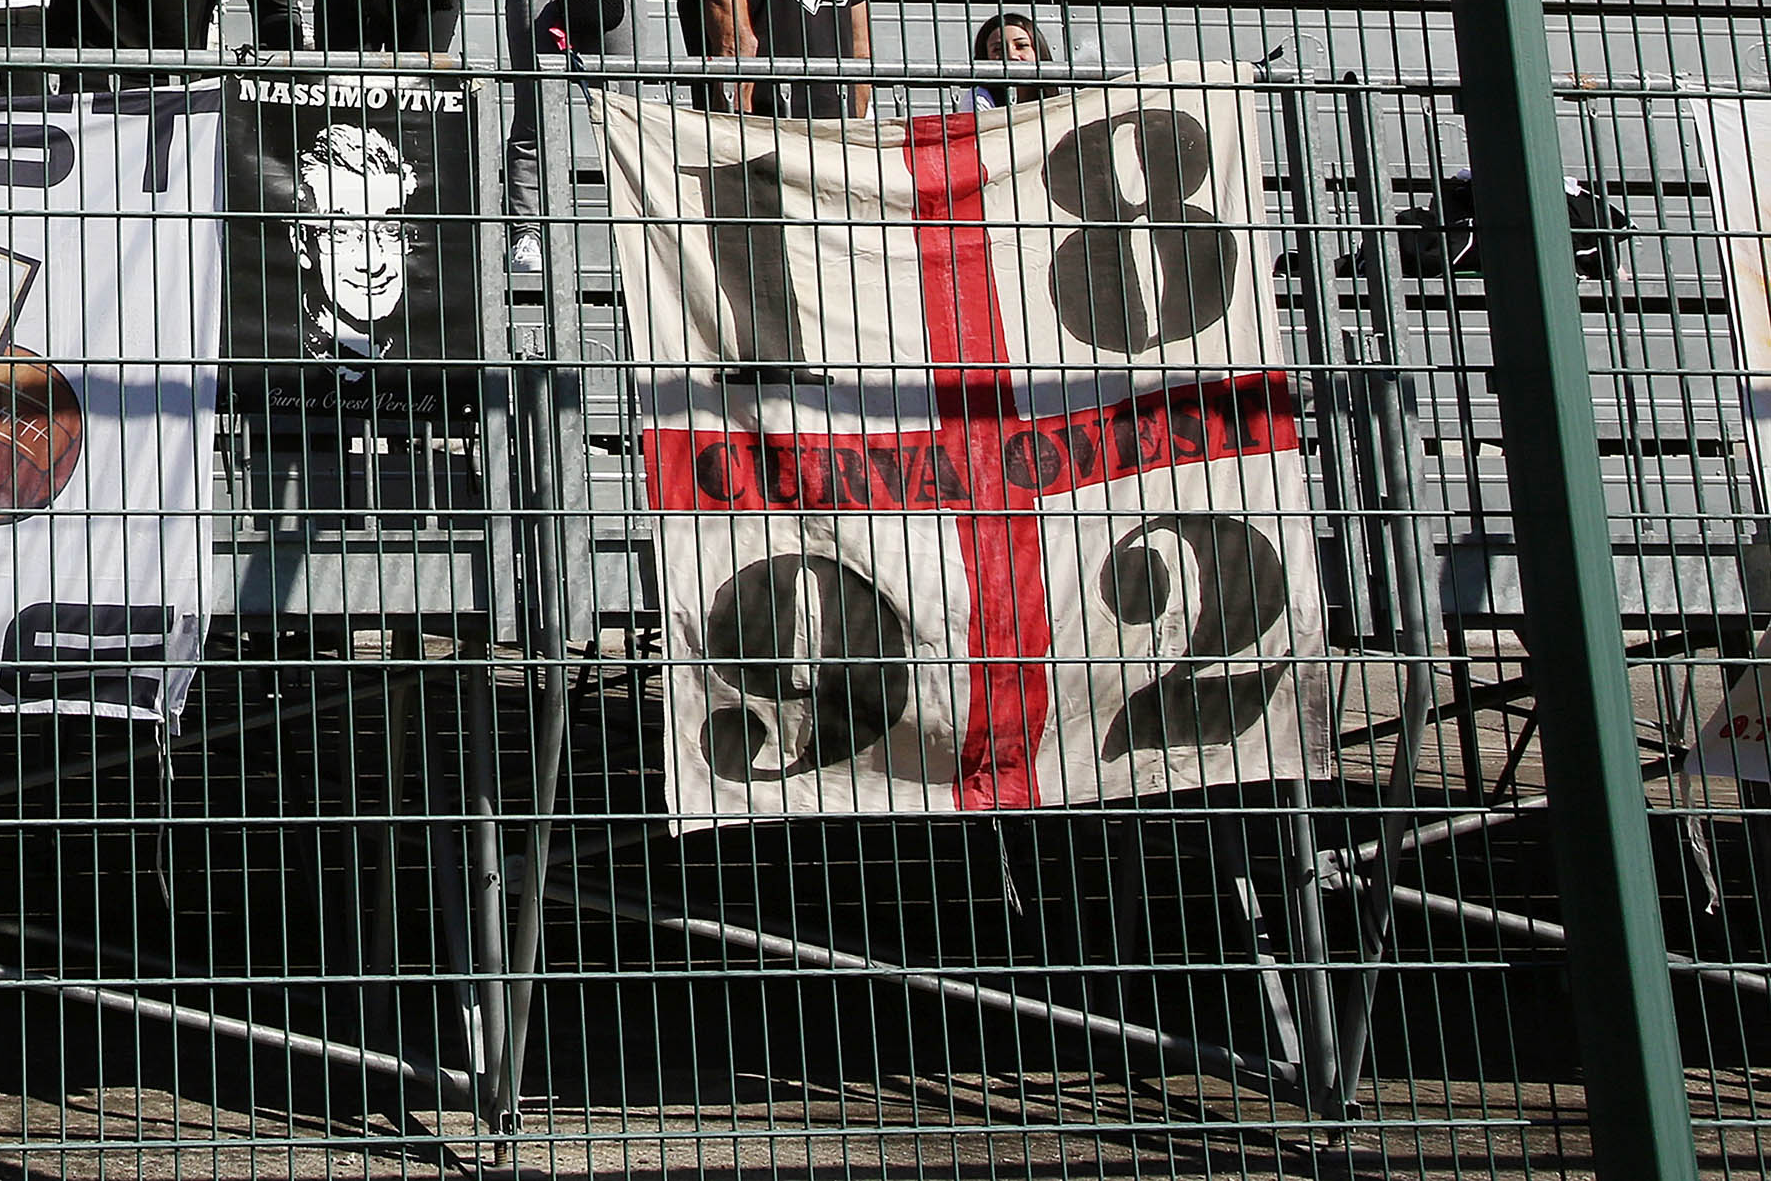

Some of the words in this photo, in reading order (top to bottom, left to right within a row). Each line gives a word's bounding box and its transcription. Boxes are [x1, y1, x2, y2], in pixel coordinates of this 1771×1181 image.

[239, 79, 388, 109] MASSIMO
[393, 88, 464, 113] VIVE
[1040, 107, 1238, 354] 8
[697, 441, 971, 506] CURVA
[1004, 386, 1262, 491] OVEST
[700, 553, 910, 784] 9
[1100, 513, 1294, 763] 2
